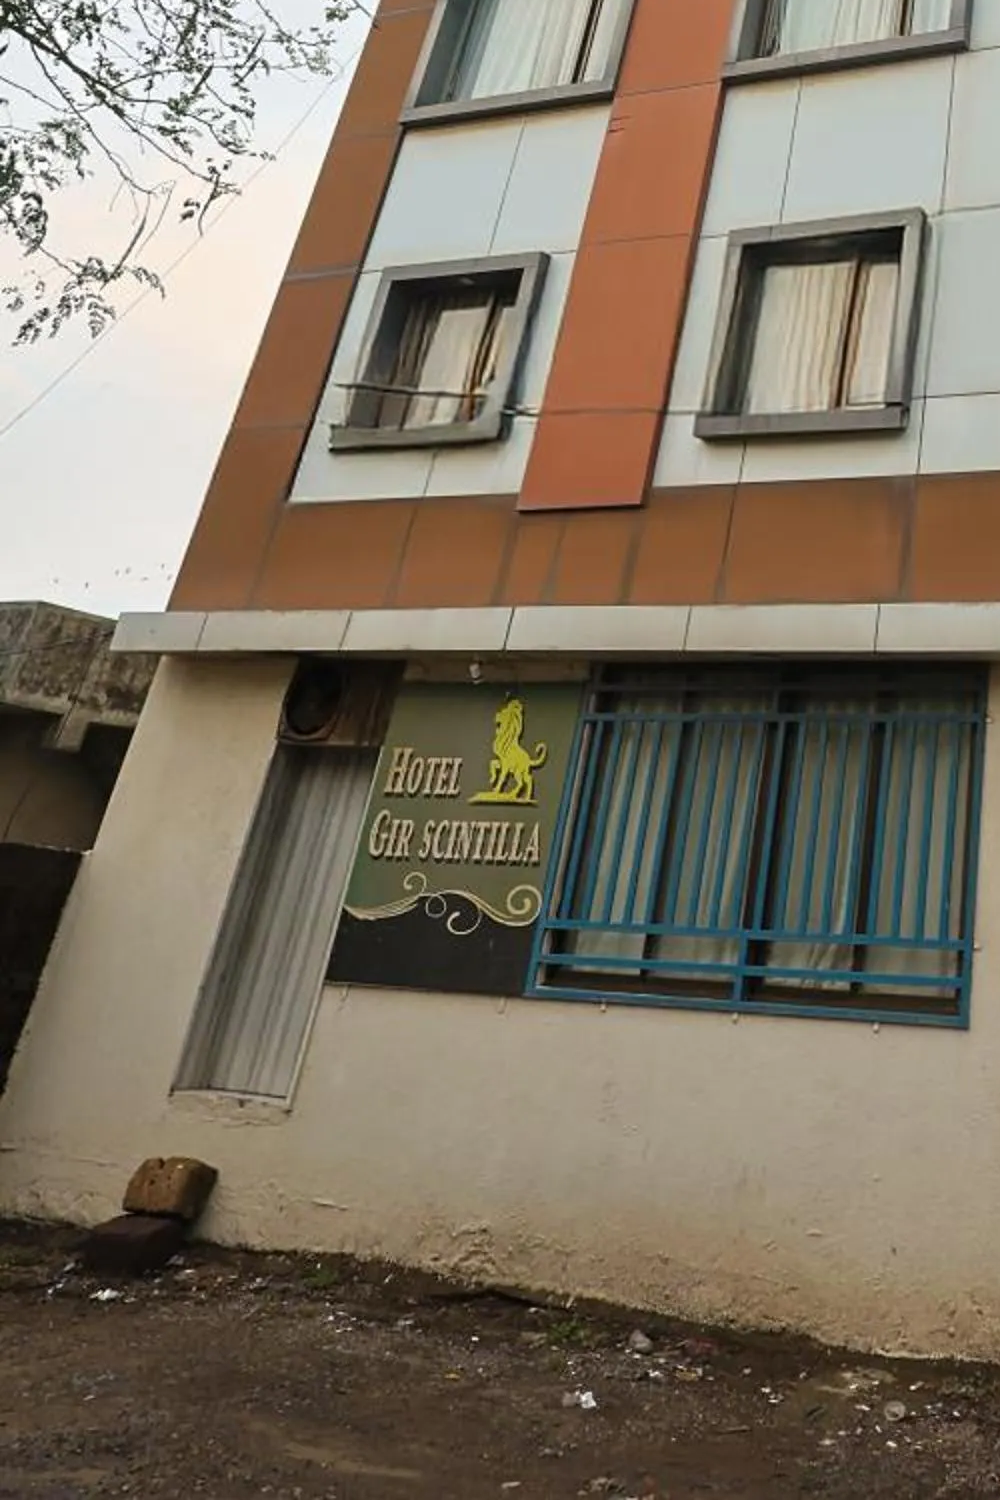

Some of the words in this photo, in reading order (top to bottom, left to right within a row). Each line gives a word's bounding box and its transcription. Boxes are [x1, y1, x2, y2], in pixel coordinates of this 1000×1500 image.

[384, 747, 463, 796] HOTEL
[368, 809, 414, 858] GIR
[418, 819, 541, 862] SCINTILLA
